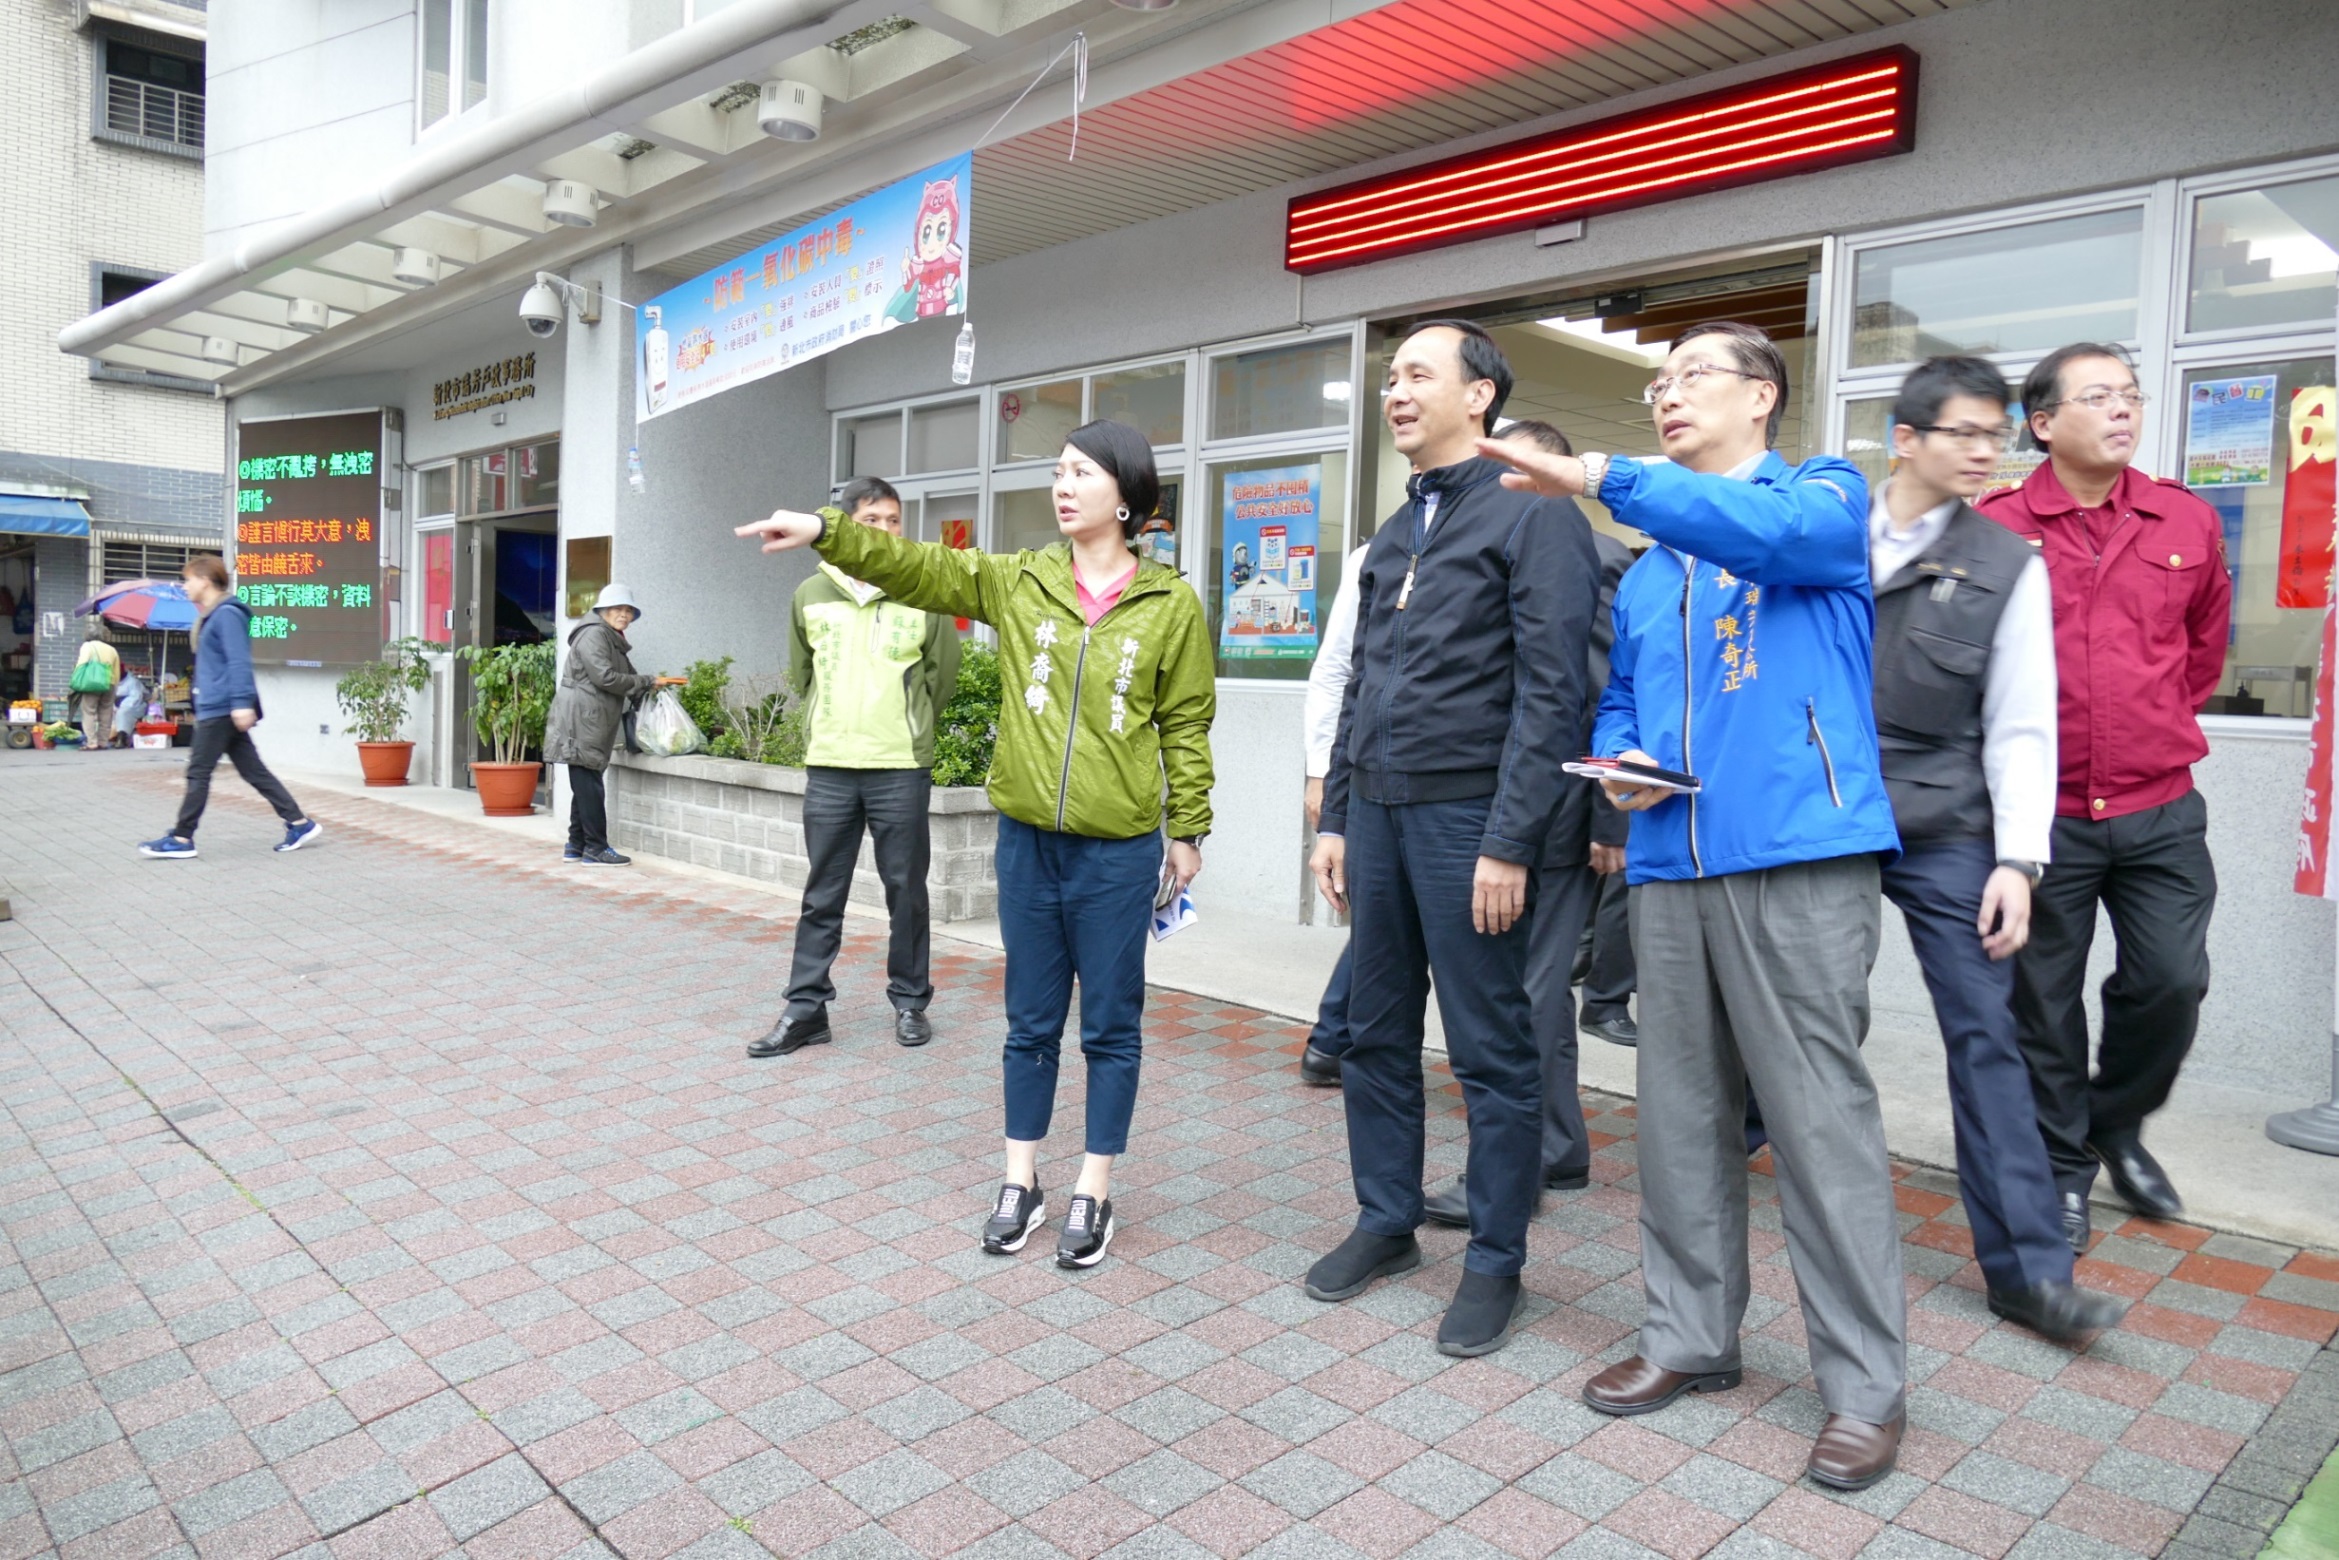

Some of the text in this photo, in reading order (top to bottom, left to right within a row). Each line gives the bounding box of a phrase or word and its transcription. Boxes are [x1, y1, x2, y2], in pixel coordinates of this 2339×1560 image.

[932, 194, 945, 207] CO
[1232, 479, 1309, 500] 危險物品不囤積
[1235, 499, 1314, 519] 公共安全好放心
[1024, 620, 1059, 716] 林裔綺
[1714, 614, 1744, 693] 陳奇正
[1109, 637, 1140, 734] 新北市議員
